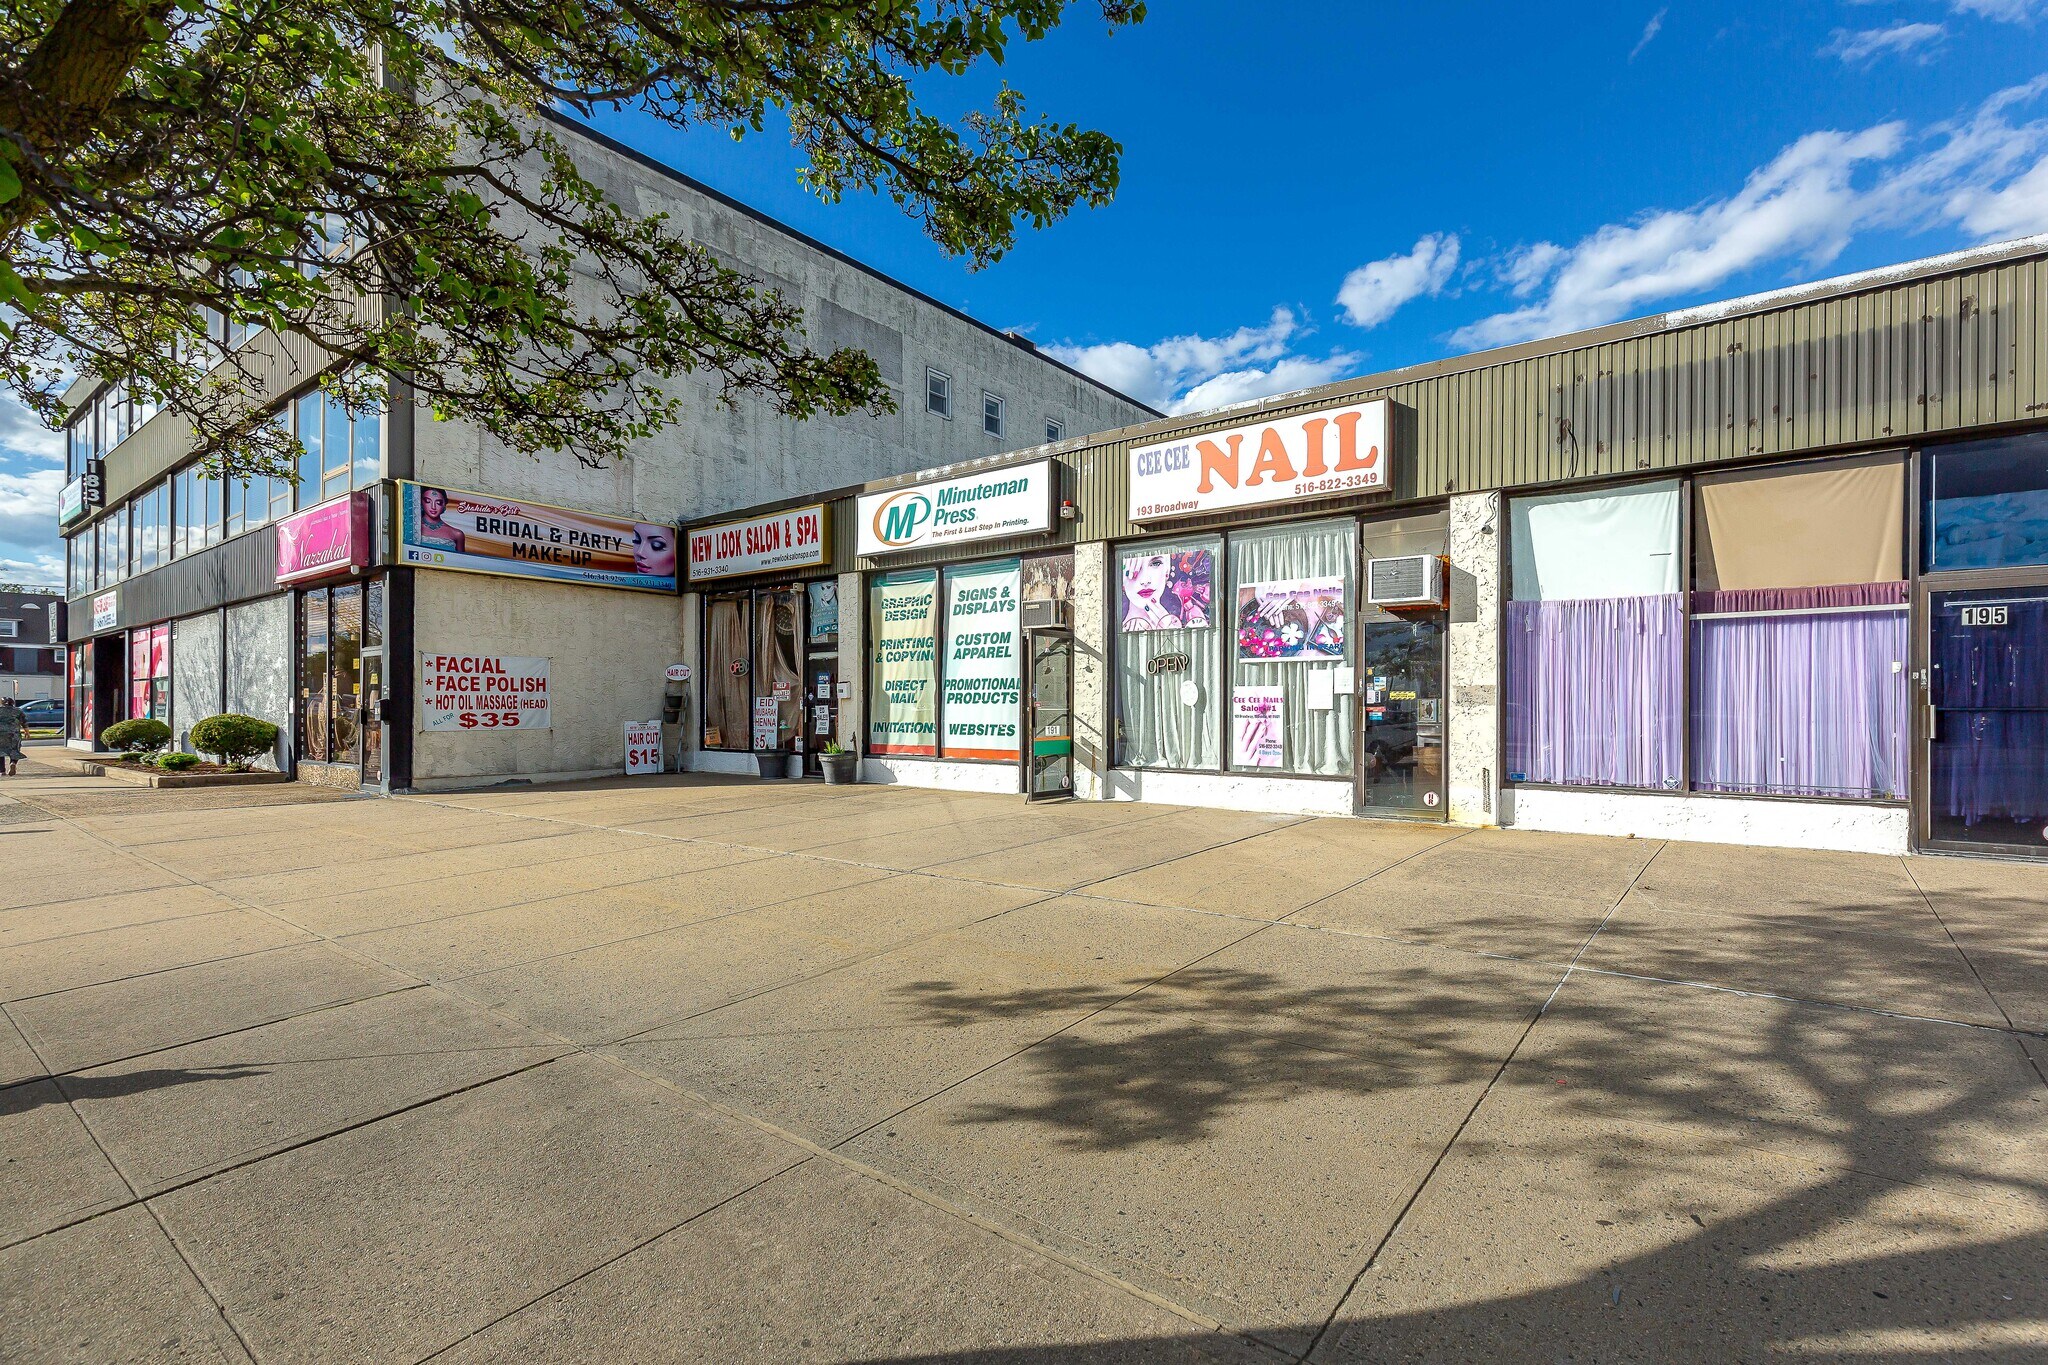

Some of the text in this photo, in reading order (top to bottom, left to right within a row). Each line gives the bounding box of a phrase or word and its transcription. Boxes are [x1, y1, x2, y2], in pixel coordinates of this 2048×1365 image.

[1137, 411, 1379, 494] CEE CEE NAIL
[87, 460, 100, 502] 183
[1294, 472, 1378, 495] 516-822-3349
[937, 477, 1028, 507] Minuteman
[500, 504, 520, 517] Best
[1136, 500, 1199, 516] 193 Broadway
[934, 507, 976, 527] Press
[476, 515, 622, 551] BRIDAL & PARTY
[944, 528, 957, 537] First
[964, 524, 977, 533] Last
[979, 523, 993, 532] Step
[1002, 517, 1029, 528] Printing.
[692, 514, 819, 563] NEW LOOK SALON & SPA
[512, 542, 592, 566] MAKE-UP
[761, 550, 819, 566] www.newlooksalonspa.com
[692, 564, 728, 577] 516-931-3340
[881, 594, 932, 609] GRAPHIC
[957, 586, 1010, 602] SIGNS &
[885, 608, 928, 621] DESIGN
[953, 599, 1016, 616] DISPLAYS
[1965, 607, 2006, 625] 195
[880, 636, 934, 650] PRINTING
[955, 631, 1012, 646] CUSTOM
[875, 652, 883, 663] &
[953, 646, 1012, 660] APPAREL
[435, 656, 507, 674] FACIAL
[731, 660, 748, 673] OPEN
[1147, 656, 1186, 674] OPEN
[436, 676, 547, 692] FACE POLISH
[885, 680, 927, 691] DIRECT
[943, 677, 1021, 690] PROMOTIONAL
[435, 694, 548, 710] HOT OIL MASSAGE (HEAD)
[760, 698, 774, 707] EID
[891, 693, 918, 704] MAIL
[946, 692, 1019, 704] PRODUCTS
[432, 712, 455, 726] ALL FOR
[756, 708, 777, 716] MUBARAK
[458, 711, 520, 729] $35
[755, 718, 776, 727] HENNA
[949, 723, 1016, 736] WEBSITES
[1047, 727, 1057, 735] 191
[628, 732, 659, 746] HAIR CUT
[755, 734, 765, 749] $5
[629, 748, 659, 767] $15
